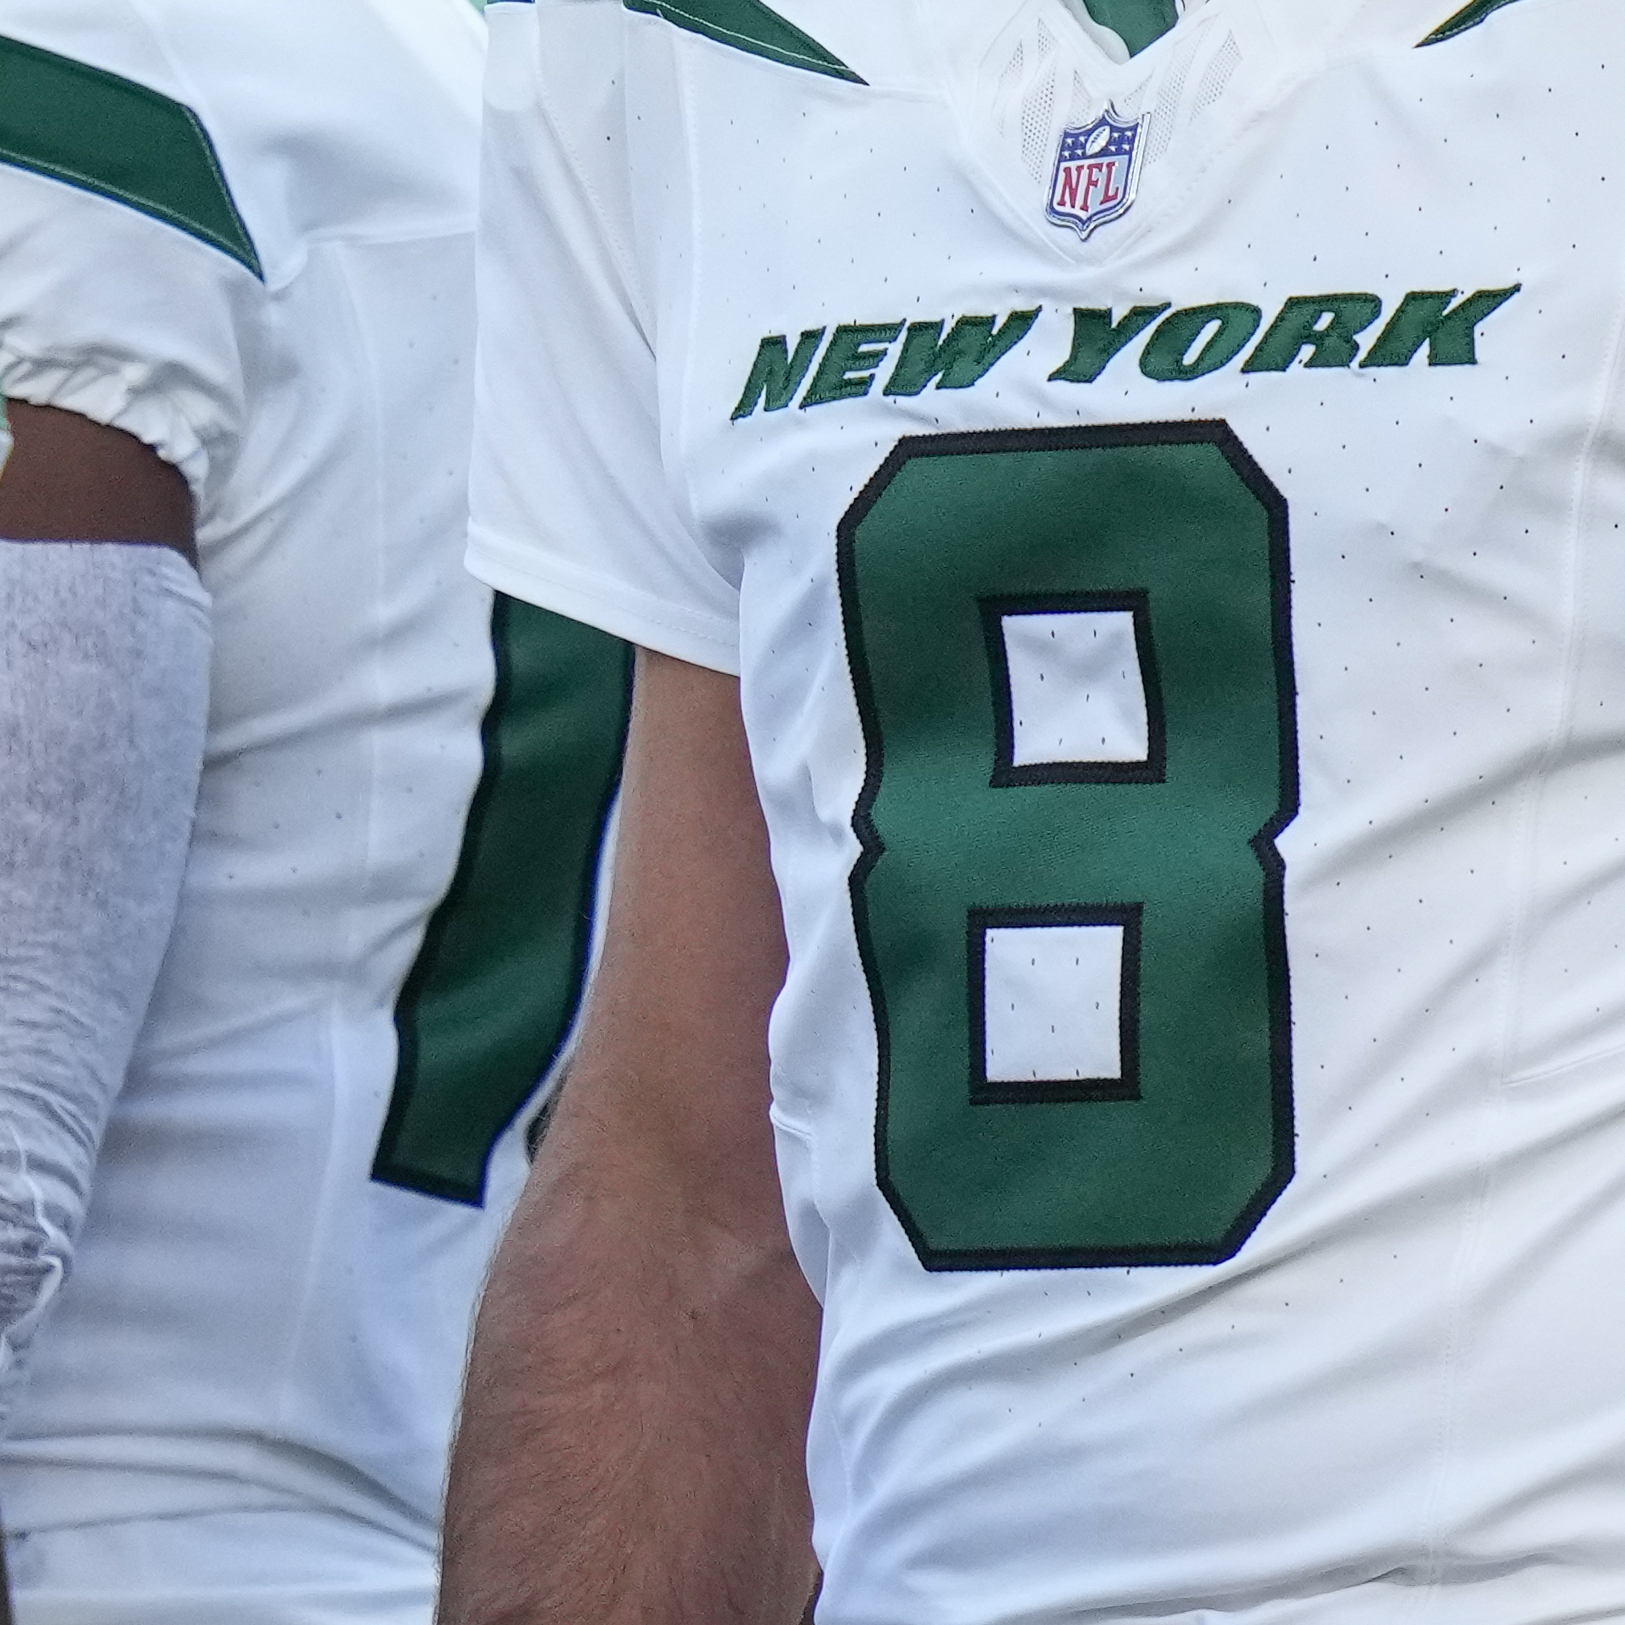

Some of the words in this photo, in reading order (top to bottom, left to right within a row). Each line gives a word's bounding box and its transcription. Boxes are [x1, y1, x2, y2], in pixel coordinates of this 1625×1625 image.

[1057, 161, 1120, 213] NFL
[730, 306, 1043, 421] NEW
[1048, 284, 1522, 382] YORK
[836, 419, 1301, 1272] 8
